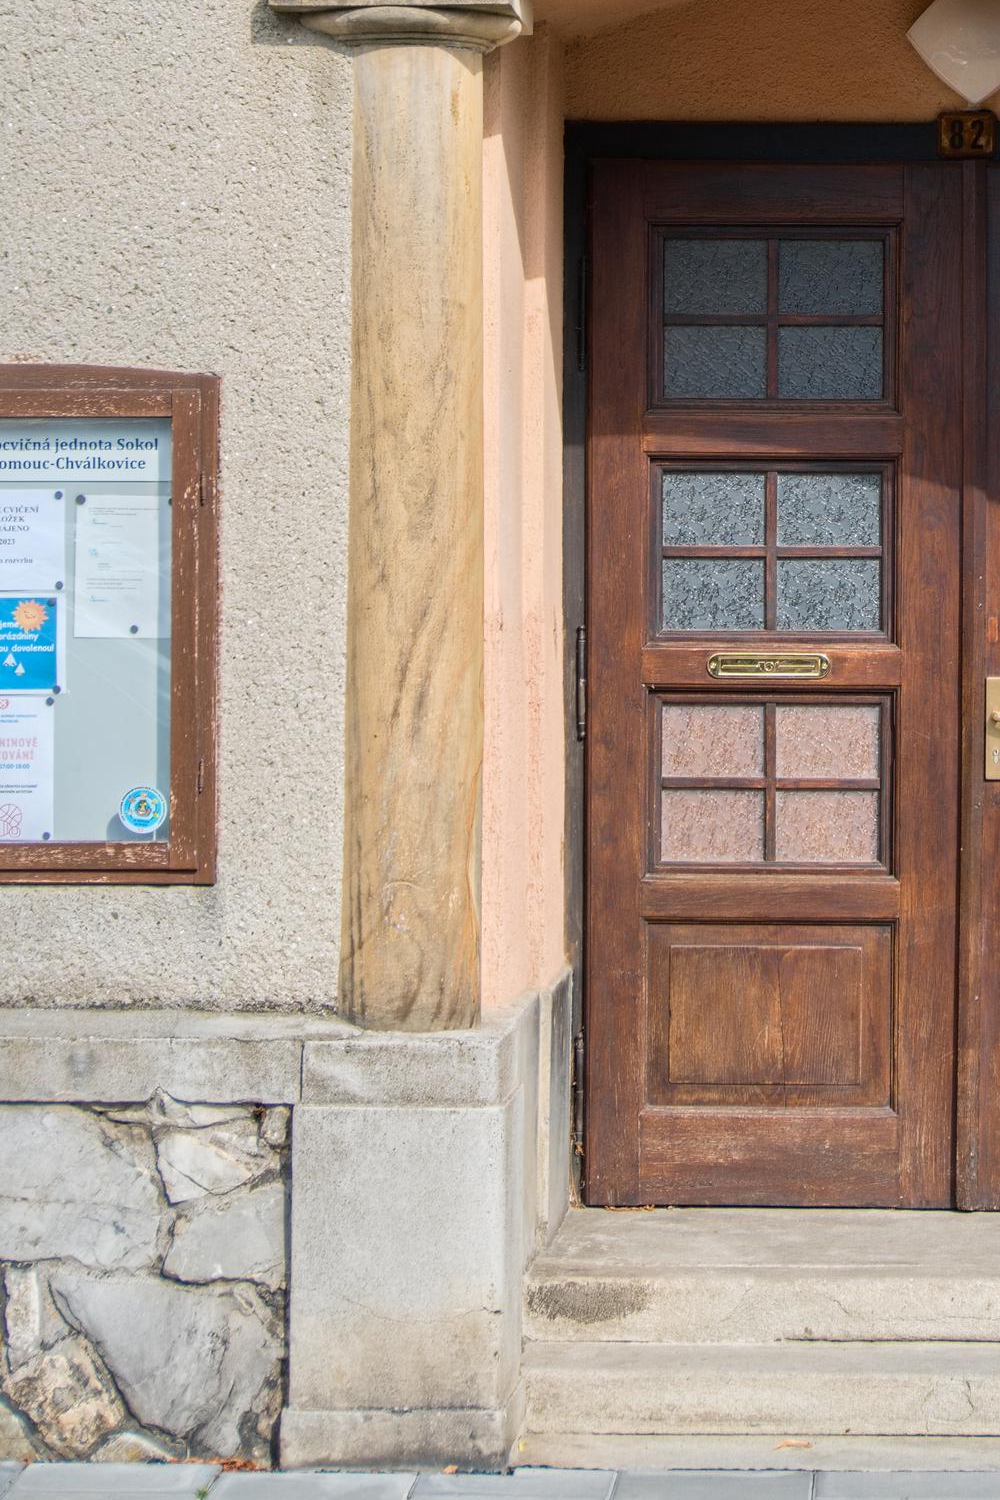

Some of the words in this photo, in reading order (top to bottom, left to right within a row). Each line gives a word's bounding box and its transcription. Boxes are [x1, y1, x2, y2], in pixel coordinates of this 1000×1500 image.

[950, 119, 985, 150] 82
[0, 437, 50, 451] cvičná
[55, 438, 114, 454] jednota
[116, 438, 159, 451] Sokol
